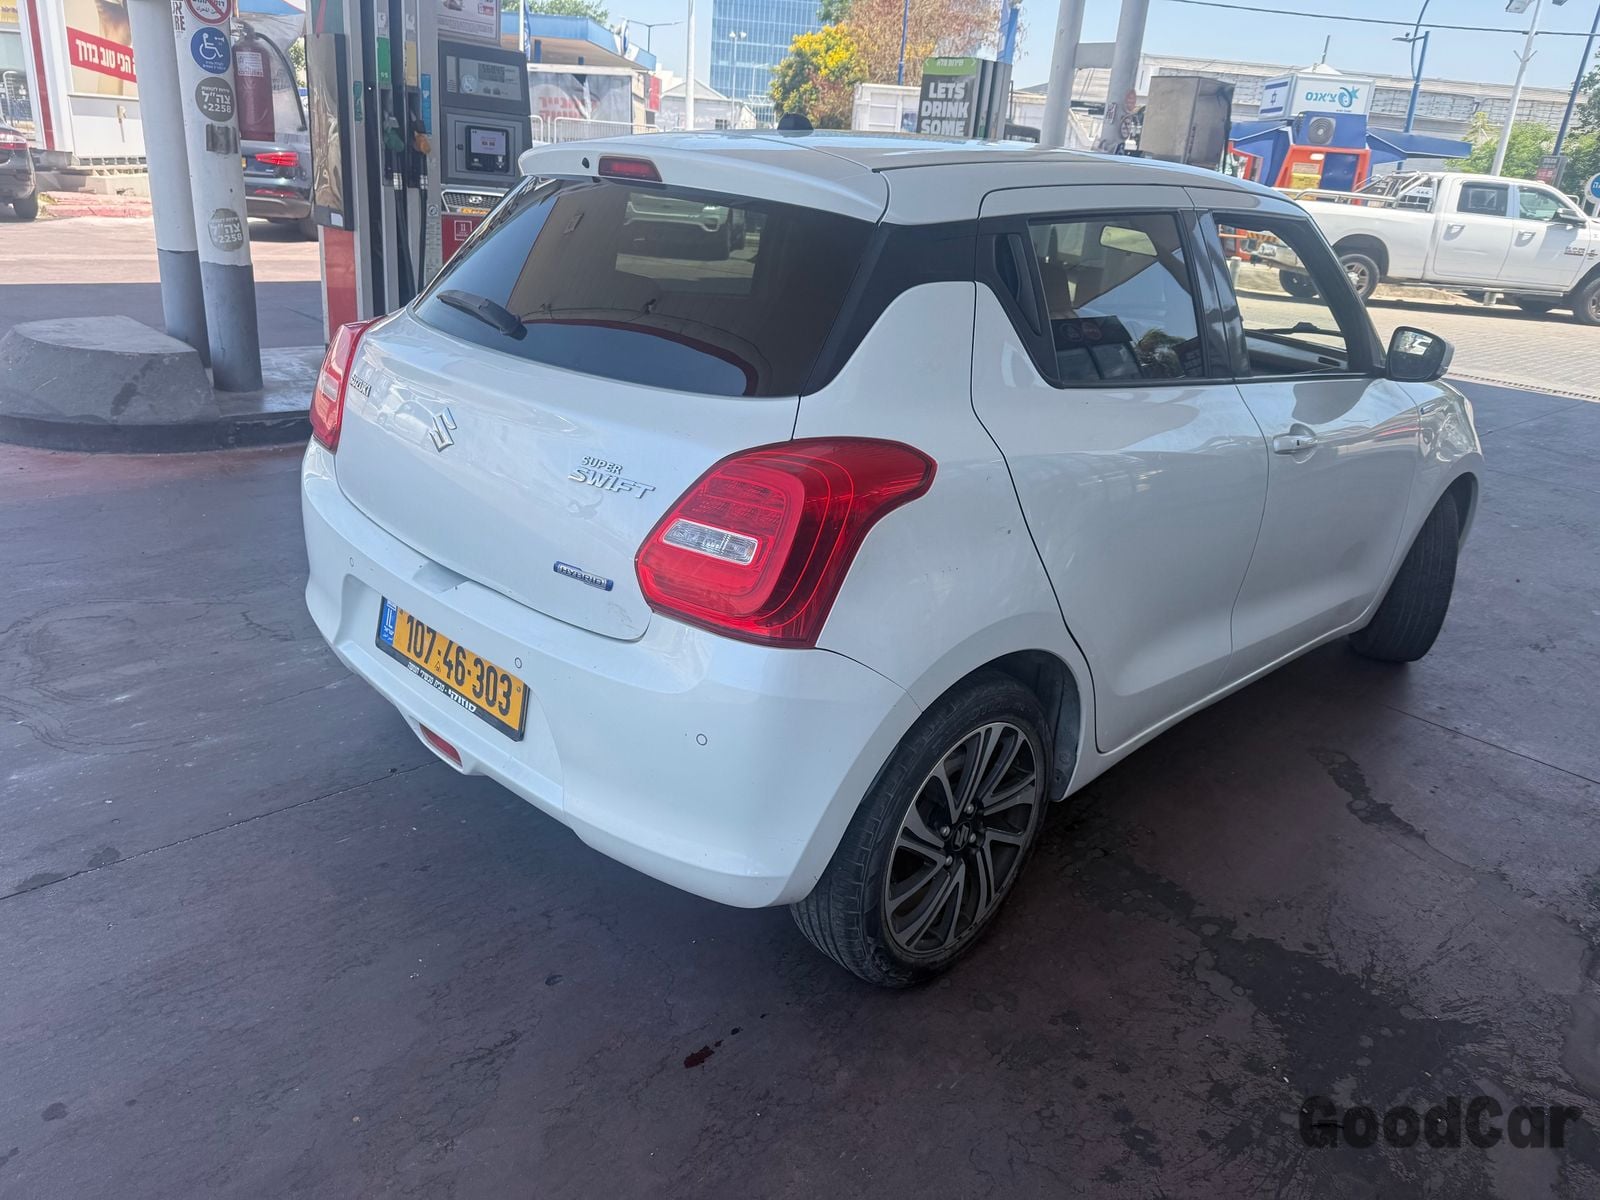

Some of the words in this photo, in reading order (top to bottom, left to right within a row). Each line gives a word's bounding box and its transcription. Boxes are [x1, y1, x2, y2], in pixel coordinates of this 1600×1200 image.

[75, 38, 99, 65] בדרך
[100, 46, 116, 69] טוב
[117, 52, 132, 75] הכי
[201, 90, 231, 105] צה"ל
[928, 81, 966, 100] LETS
[920, 101, 970, 118] DRINK
[920, 119, 966, 137] SOME
[581, 455, 624, 475] SUPER
[567, 466, 657, 499] SWIFT
[560, 566, 604, 586] HYBRID
[448, 689, 477, 713] סוזוקי
